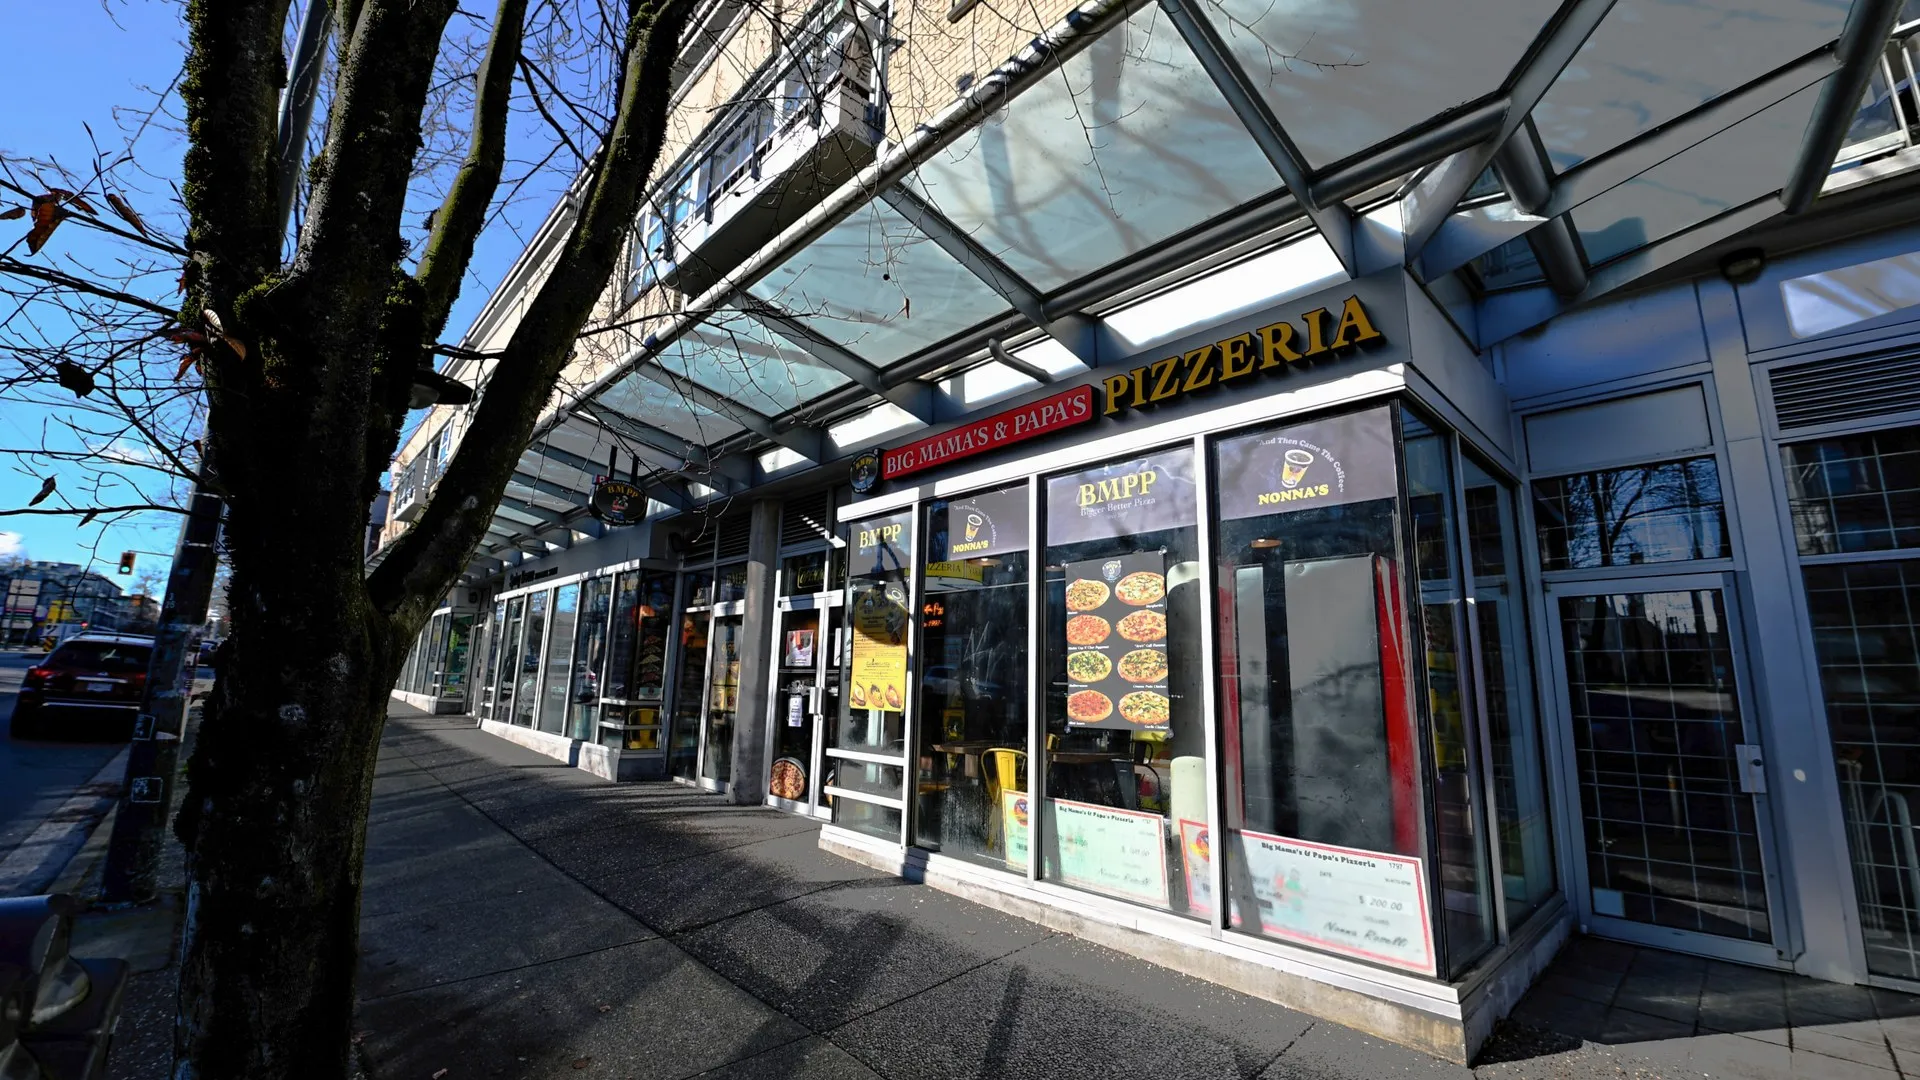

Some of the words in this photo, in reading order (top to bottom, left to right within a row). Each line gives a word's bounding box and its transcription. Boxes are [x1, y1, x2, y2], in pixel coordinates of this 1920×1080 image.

[1102, 295, 1381, 416] PIZZERIA
[886, 451, 914, 475] BIG
[919, 426, 988, 464] MAMA'S
[993, 422, 1008, 441] &
[1014, 394, 1087, 436] PAPA'S
[1277, 437, 1298, 446] Then
[1300, 440, 1321, 453] Came
[1079, 470, 1157, 507] BMPP
[1258, 484, 1329, 505] NONNA'S
[1107, 501, 1132, 512] Better
[1134, 498, 1156, 507] Pizza
[859, 523, 902, 548] BMPP
[953, 539, 989, 553] NONNA'S
[926, 562, 961, 573] IZZERIA
[1068, 807, 1086, 815] Mama's
[1093, 812, 1110, 820] Papa's
[1111, 815, 1134, 824] Pizzeria
[1261, 842, 1273, 851] Big
[1274, 844, 1302, 856] Mama's
[1313, 851, 1339, 863] Papa's
[1341, 856, 1376, 868] Pizzeria
[1389, 862, 1403, 871] 1797
